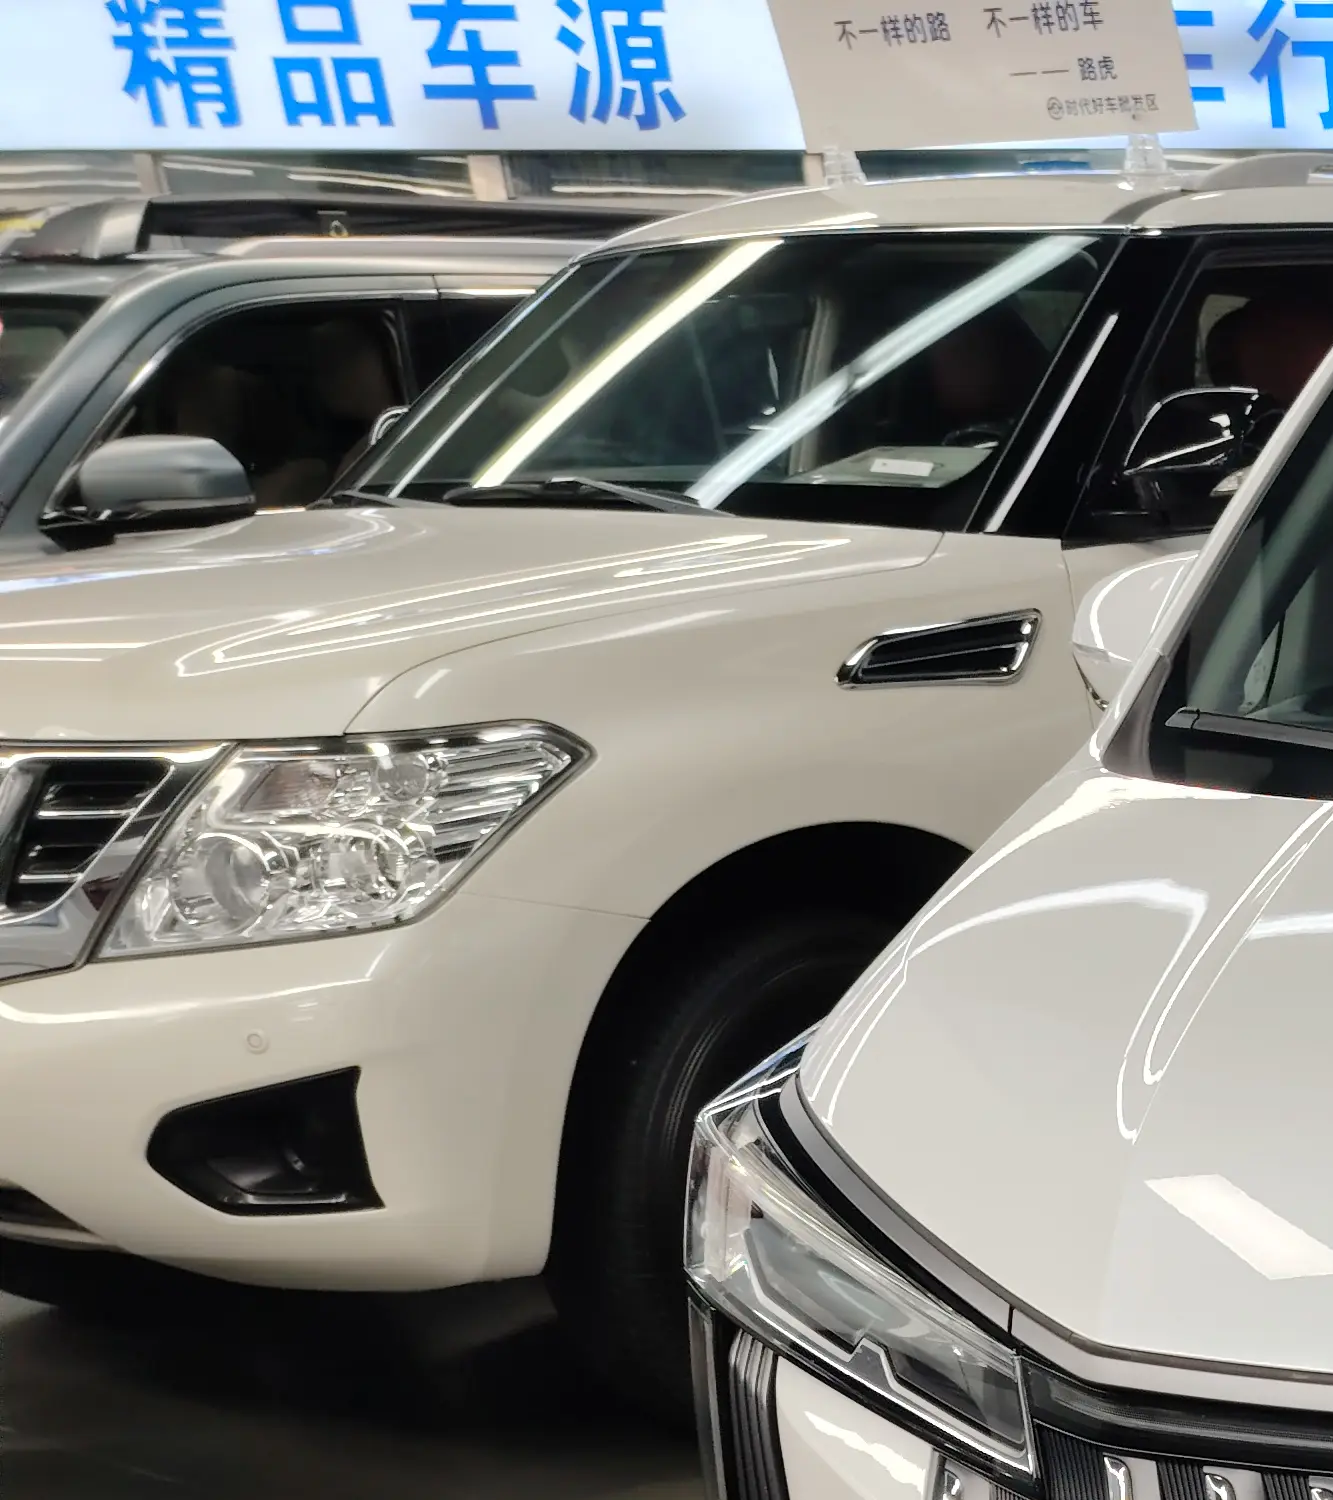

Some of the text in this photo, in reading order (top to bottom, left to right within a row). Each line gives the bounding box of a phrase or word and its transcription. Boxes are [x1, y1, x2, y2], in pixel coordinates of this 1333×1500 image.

[112, 0, 686, 131] 精品车源
[834, 0, 1105, 50] 不一样的路 不一样的车
